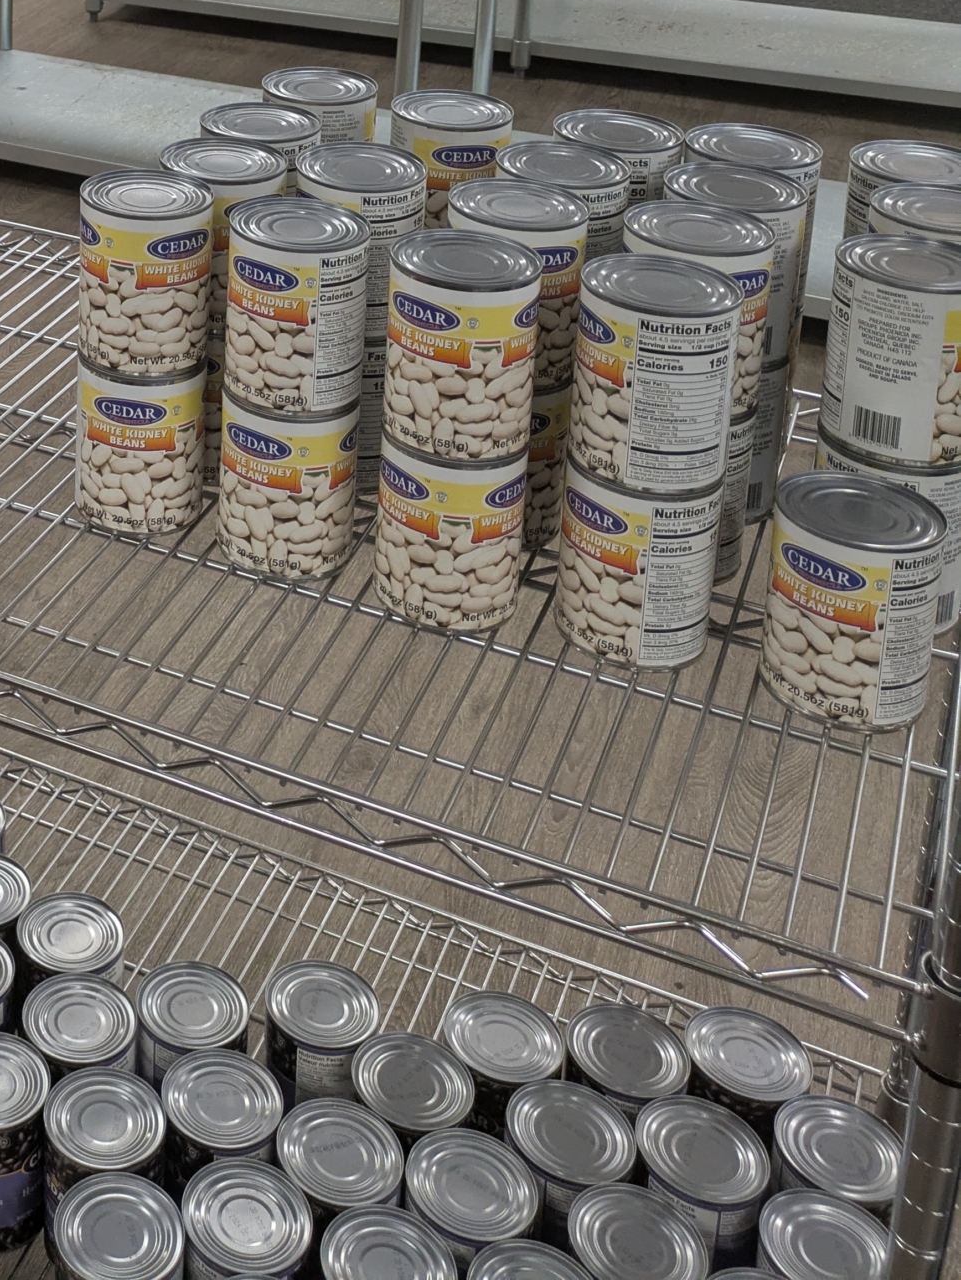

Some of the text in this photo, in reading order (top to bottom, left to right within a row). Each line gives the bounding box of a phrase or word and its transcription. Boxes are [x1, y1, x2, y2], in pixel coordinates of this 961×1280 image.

[442, 151, 491, 162] CEDAR
[430, 170, 462, 180] WHITE
[362, 196, 409, 206] Nutrition
[158, 234, 205, 254] CEDAR
[144, 263, 180, 274] WHITE
[322, 252, 362, 268] Nutrition
[167, 270, 198, 284] BEANS
[236, 260, 286, 286] CEDAR
[256, 290, 300, 310] KIDNEY
[320, 290, 353, 302] Calories
[242, 299, 274, 317] BEANS
[397, 297, 456, 328] CEDAR
[640, 321, 732, 334] Nutrition Facts
[869, 317, 897, 330] PREPARED
[401, 336, 435, 358] BEANS
[424, 332, 462, 350] KIDNEY
[639, 333, 657, 342] about
[670, 336, 695, 344] servings
[639, 340, 666, 350] Serving
[637, 354, 728, 372] Calories 150
[857, 348, 882, 361] PRODUCT
[892, 357, 918, 368] CANADA
[102, 401, 156, 419] CEDAR
[92, 418, 168, 440] WHITE KIDNEY
[110, 436, 146, 449] BEANS
[231, 429, 282, 458] CEDAR
[236, 464, 269, 484] BEANS
[250, 458, 292, 478] KIDNEY
[392, 497, 430, 520] KIDNEY
[568, 492, 625, 532] CEDAR
[654, 508, 706, 519] Nutrition
[570, 530, 602, 559] BEANS
[587, 534, 628, 556] KIDNEY
[651, 545, 692, 554] Calories
[788, 548, 852, 588] CEDAR
[894, 552, 940, 570] Nutrition
[778, 568, 866, 612] WHITE KIDNEY
[892, 578, 916, 586] Serving
[793, 591, 835, 617] BEANS
[890, 595, 928, 606] Calories
